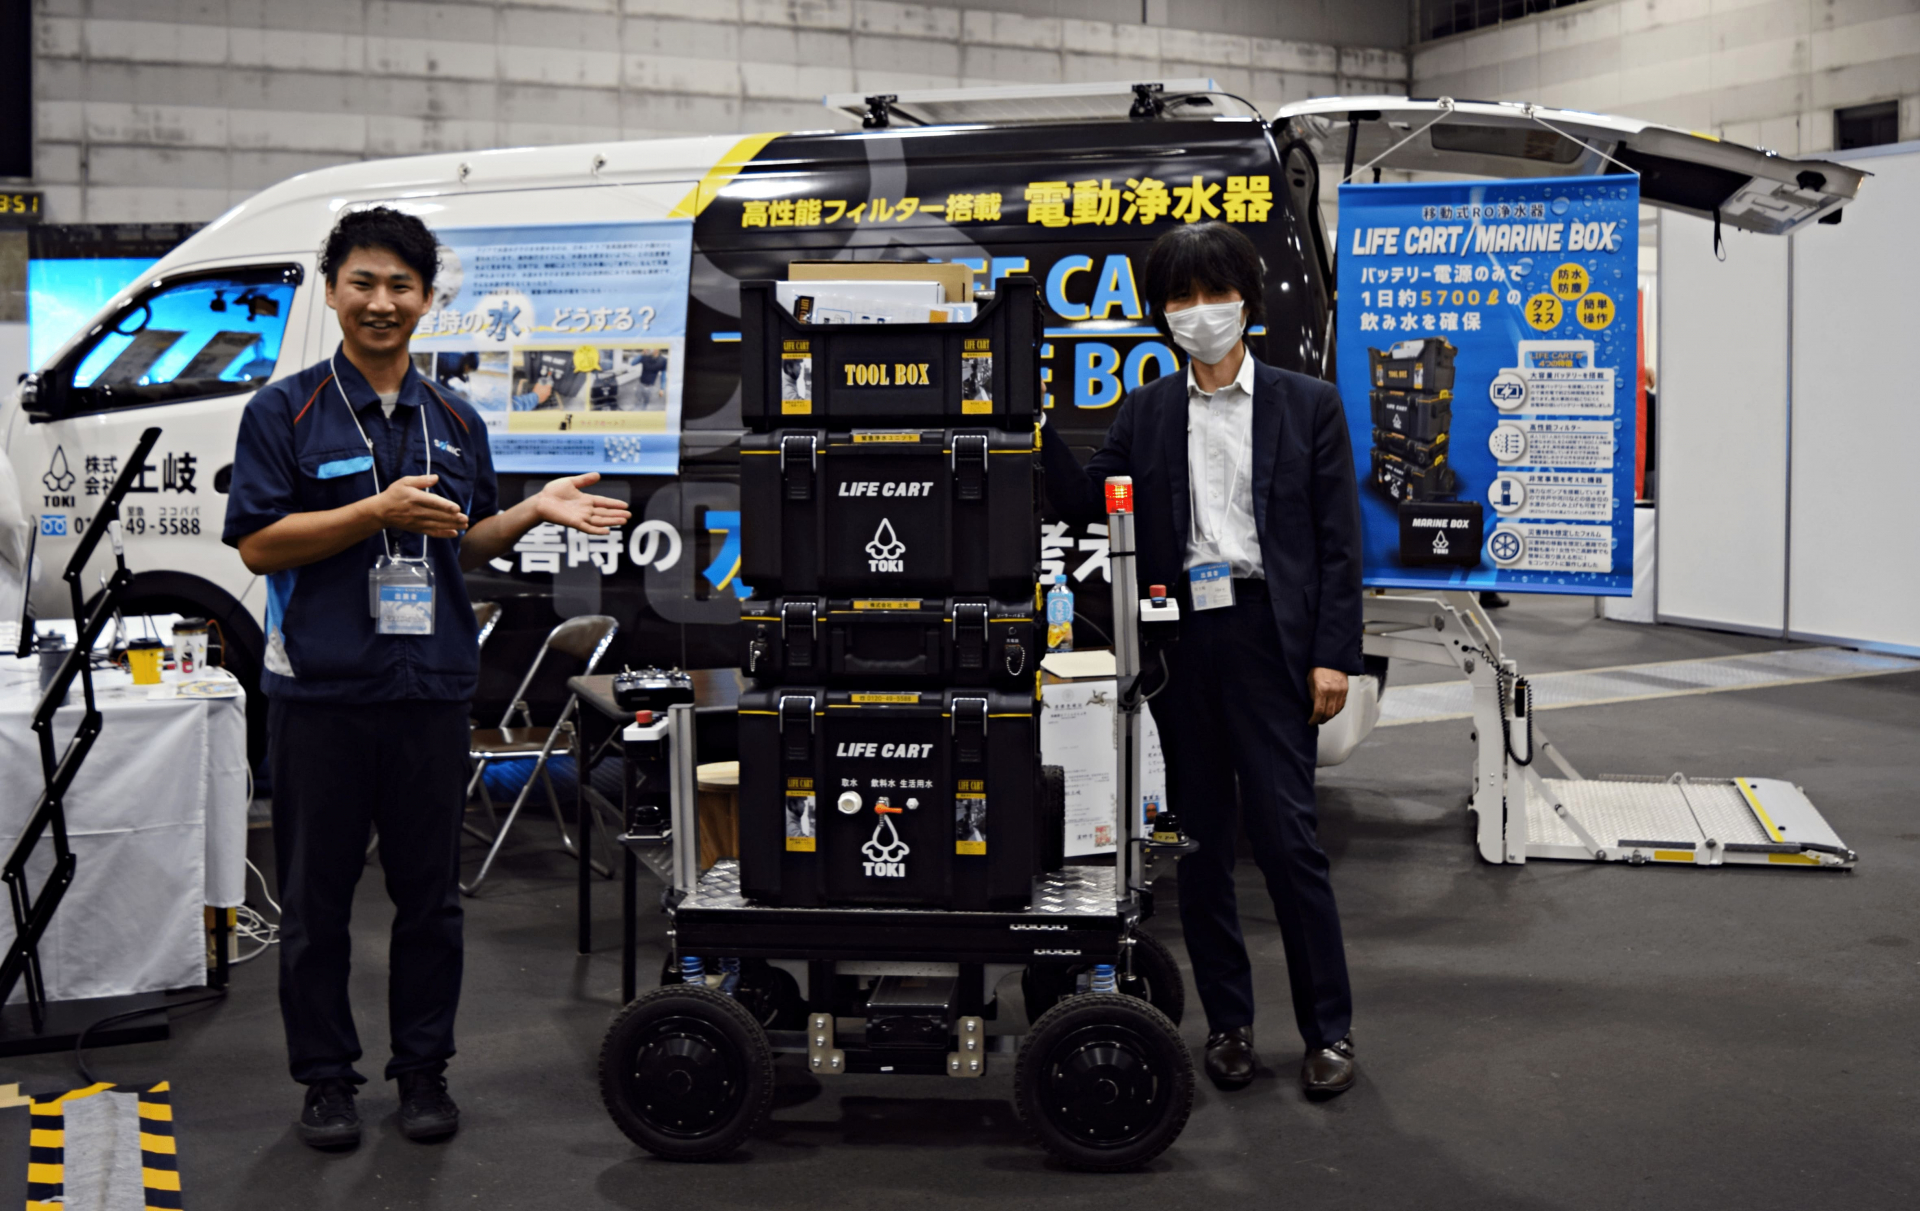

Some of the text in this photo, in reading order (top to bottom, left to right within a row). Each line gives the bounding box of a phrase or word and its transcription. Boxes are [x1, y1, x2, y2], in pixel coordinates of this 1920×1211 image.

[741, 175, 1274, 228] 高性能フィルター搭載 電動浄水器
[1423, 203, 1545, 220] 移動式RO浄水器
[1352, 228, 1400, 256] LIFE
[1568, 222, 1616, 251] BOX
[1361, 264, 1522, 284] バッテリー電源のみで
[1558, 269, 1582, 280] 防水
[1045, 254, 1150, 320] CA
[1558, 283, 1582, 294] 防塵
[1532, 299, 1555, 311] タフ
[1583, 299, 1608, 310] 簡単
[552, 306, 656, 332] どうする？
[1360, 312, 1481, 331] 飲み水を確保
[1532, 313, 1555, 325] ネス
[1583, 313, 1608, 324] 操作
[845, 364, 930, 386] TOOL BOX
[1074, 341, 1182, 409] BO
[85, 456, 117, 474] 株式
[838, 482, 933, 497] LIFE CART
[43, 495, 75, 507] TOKI
[1412, 518, 1469, 528] MARINE BOX
[868, 560, 903, 572] TOKI
[837, 743, 933, 758] LIFE CART
[841, 778, 933, 788] 取水 飲料水 生活用水
[863, 862, 905, 877] TOKI
